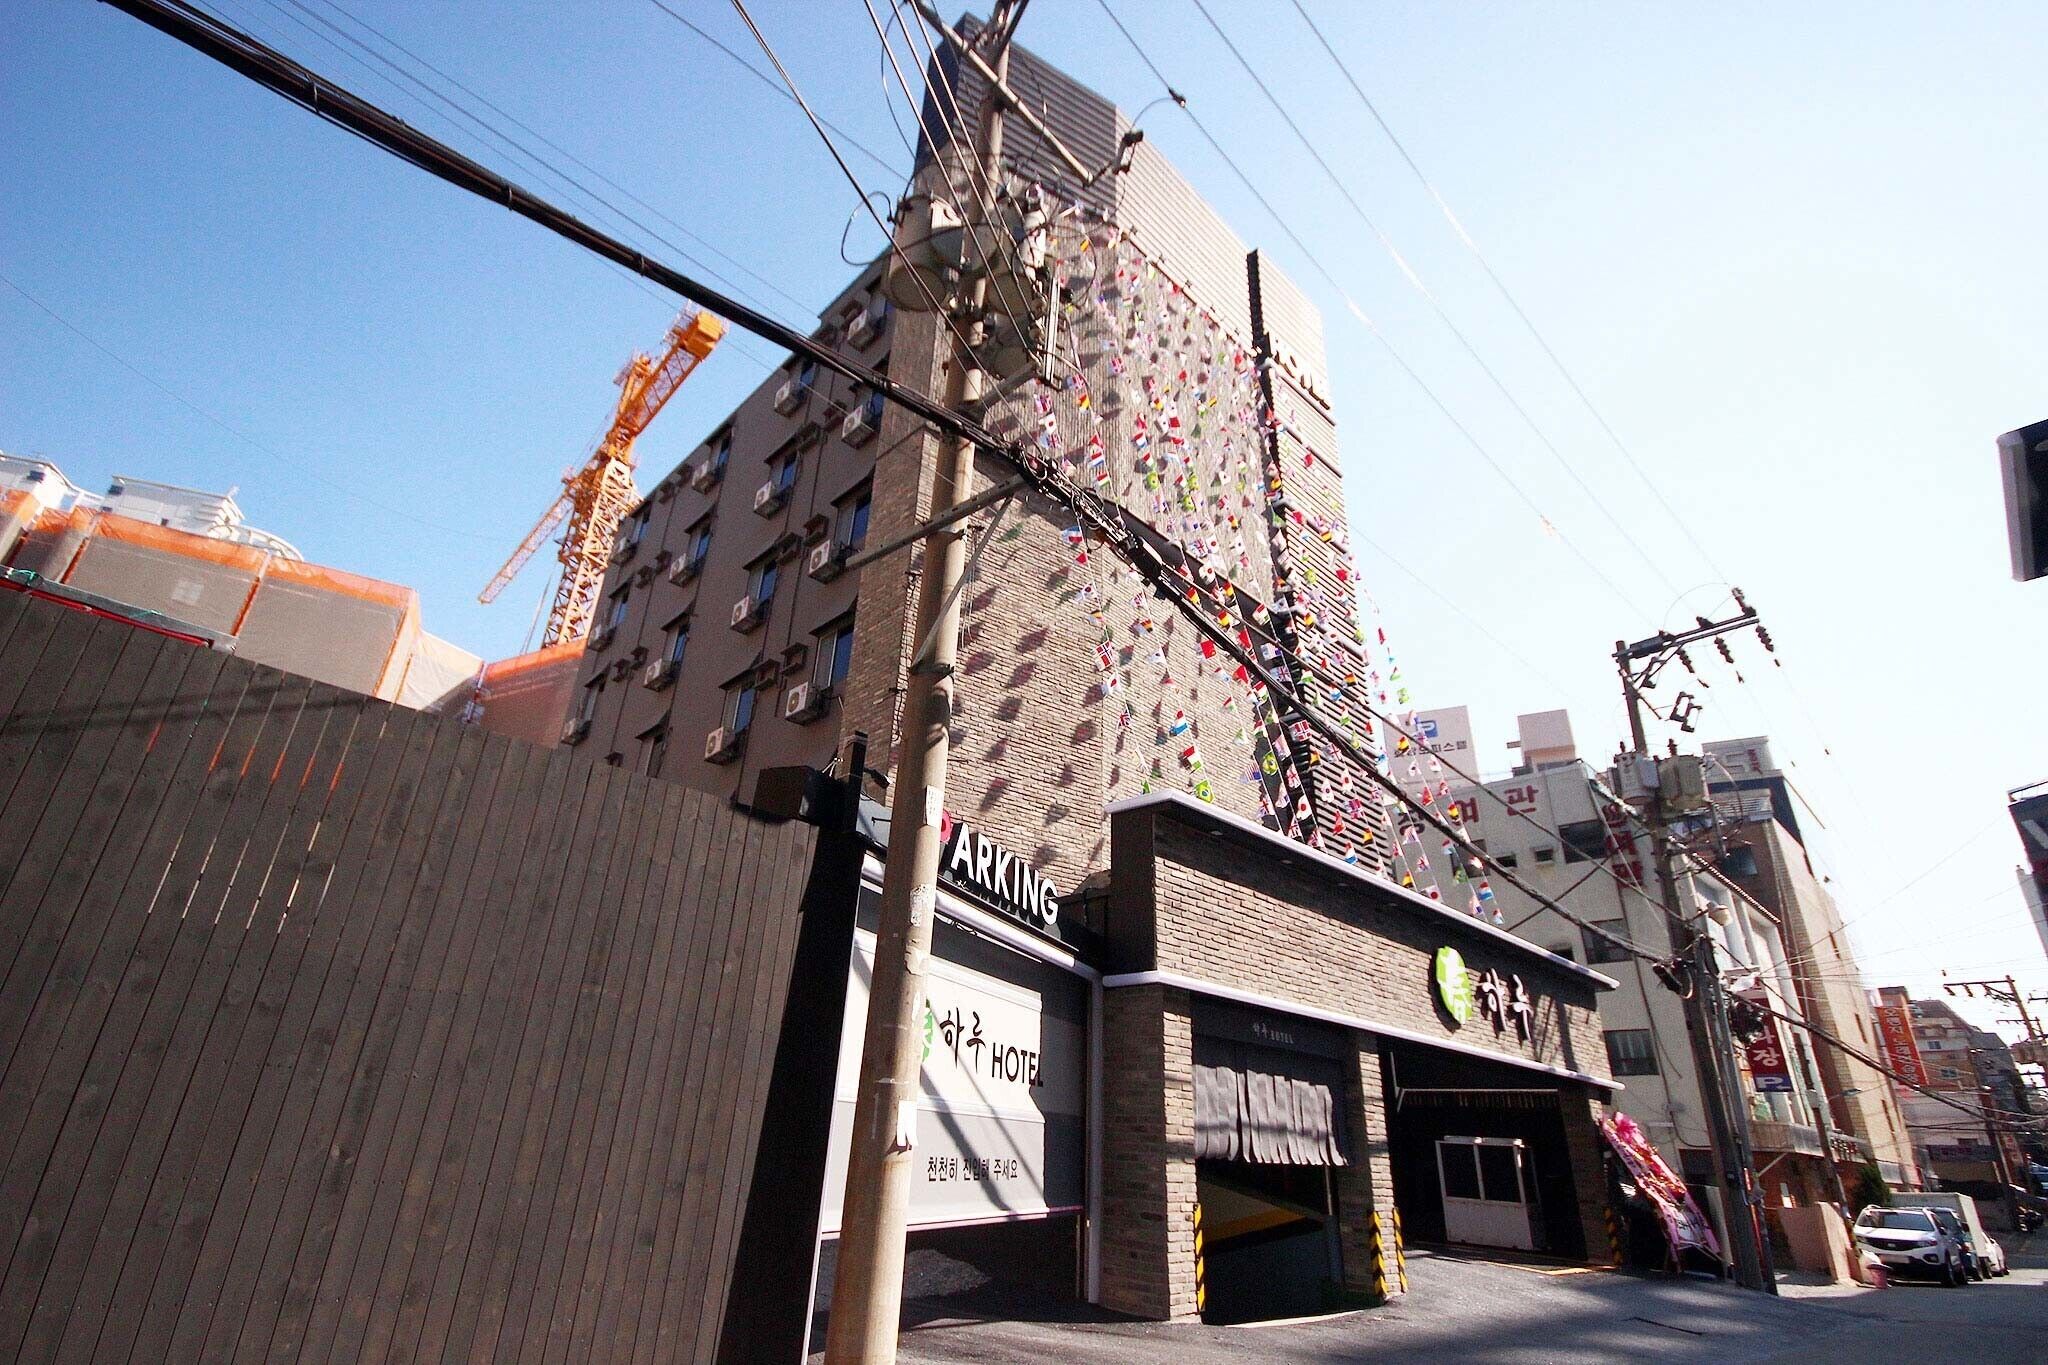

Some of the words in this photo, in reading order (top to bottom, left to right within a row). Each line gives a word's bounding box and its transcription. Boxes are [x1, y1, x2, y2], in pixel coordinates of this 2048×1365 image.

[1480, 968, 1534, 1042] 하루
[939, 1006, 986, 1074] 하루
[992, 1042, 1044, 1087] HOTEL
[927, 1156, 958, 1182] 천천히
[963, 1157, 990, 1182] 진입해
[993, 1158, 1018, 1182] 주세요
